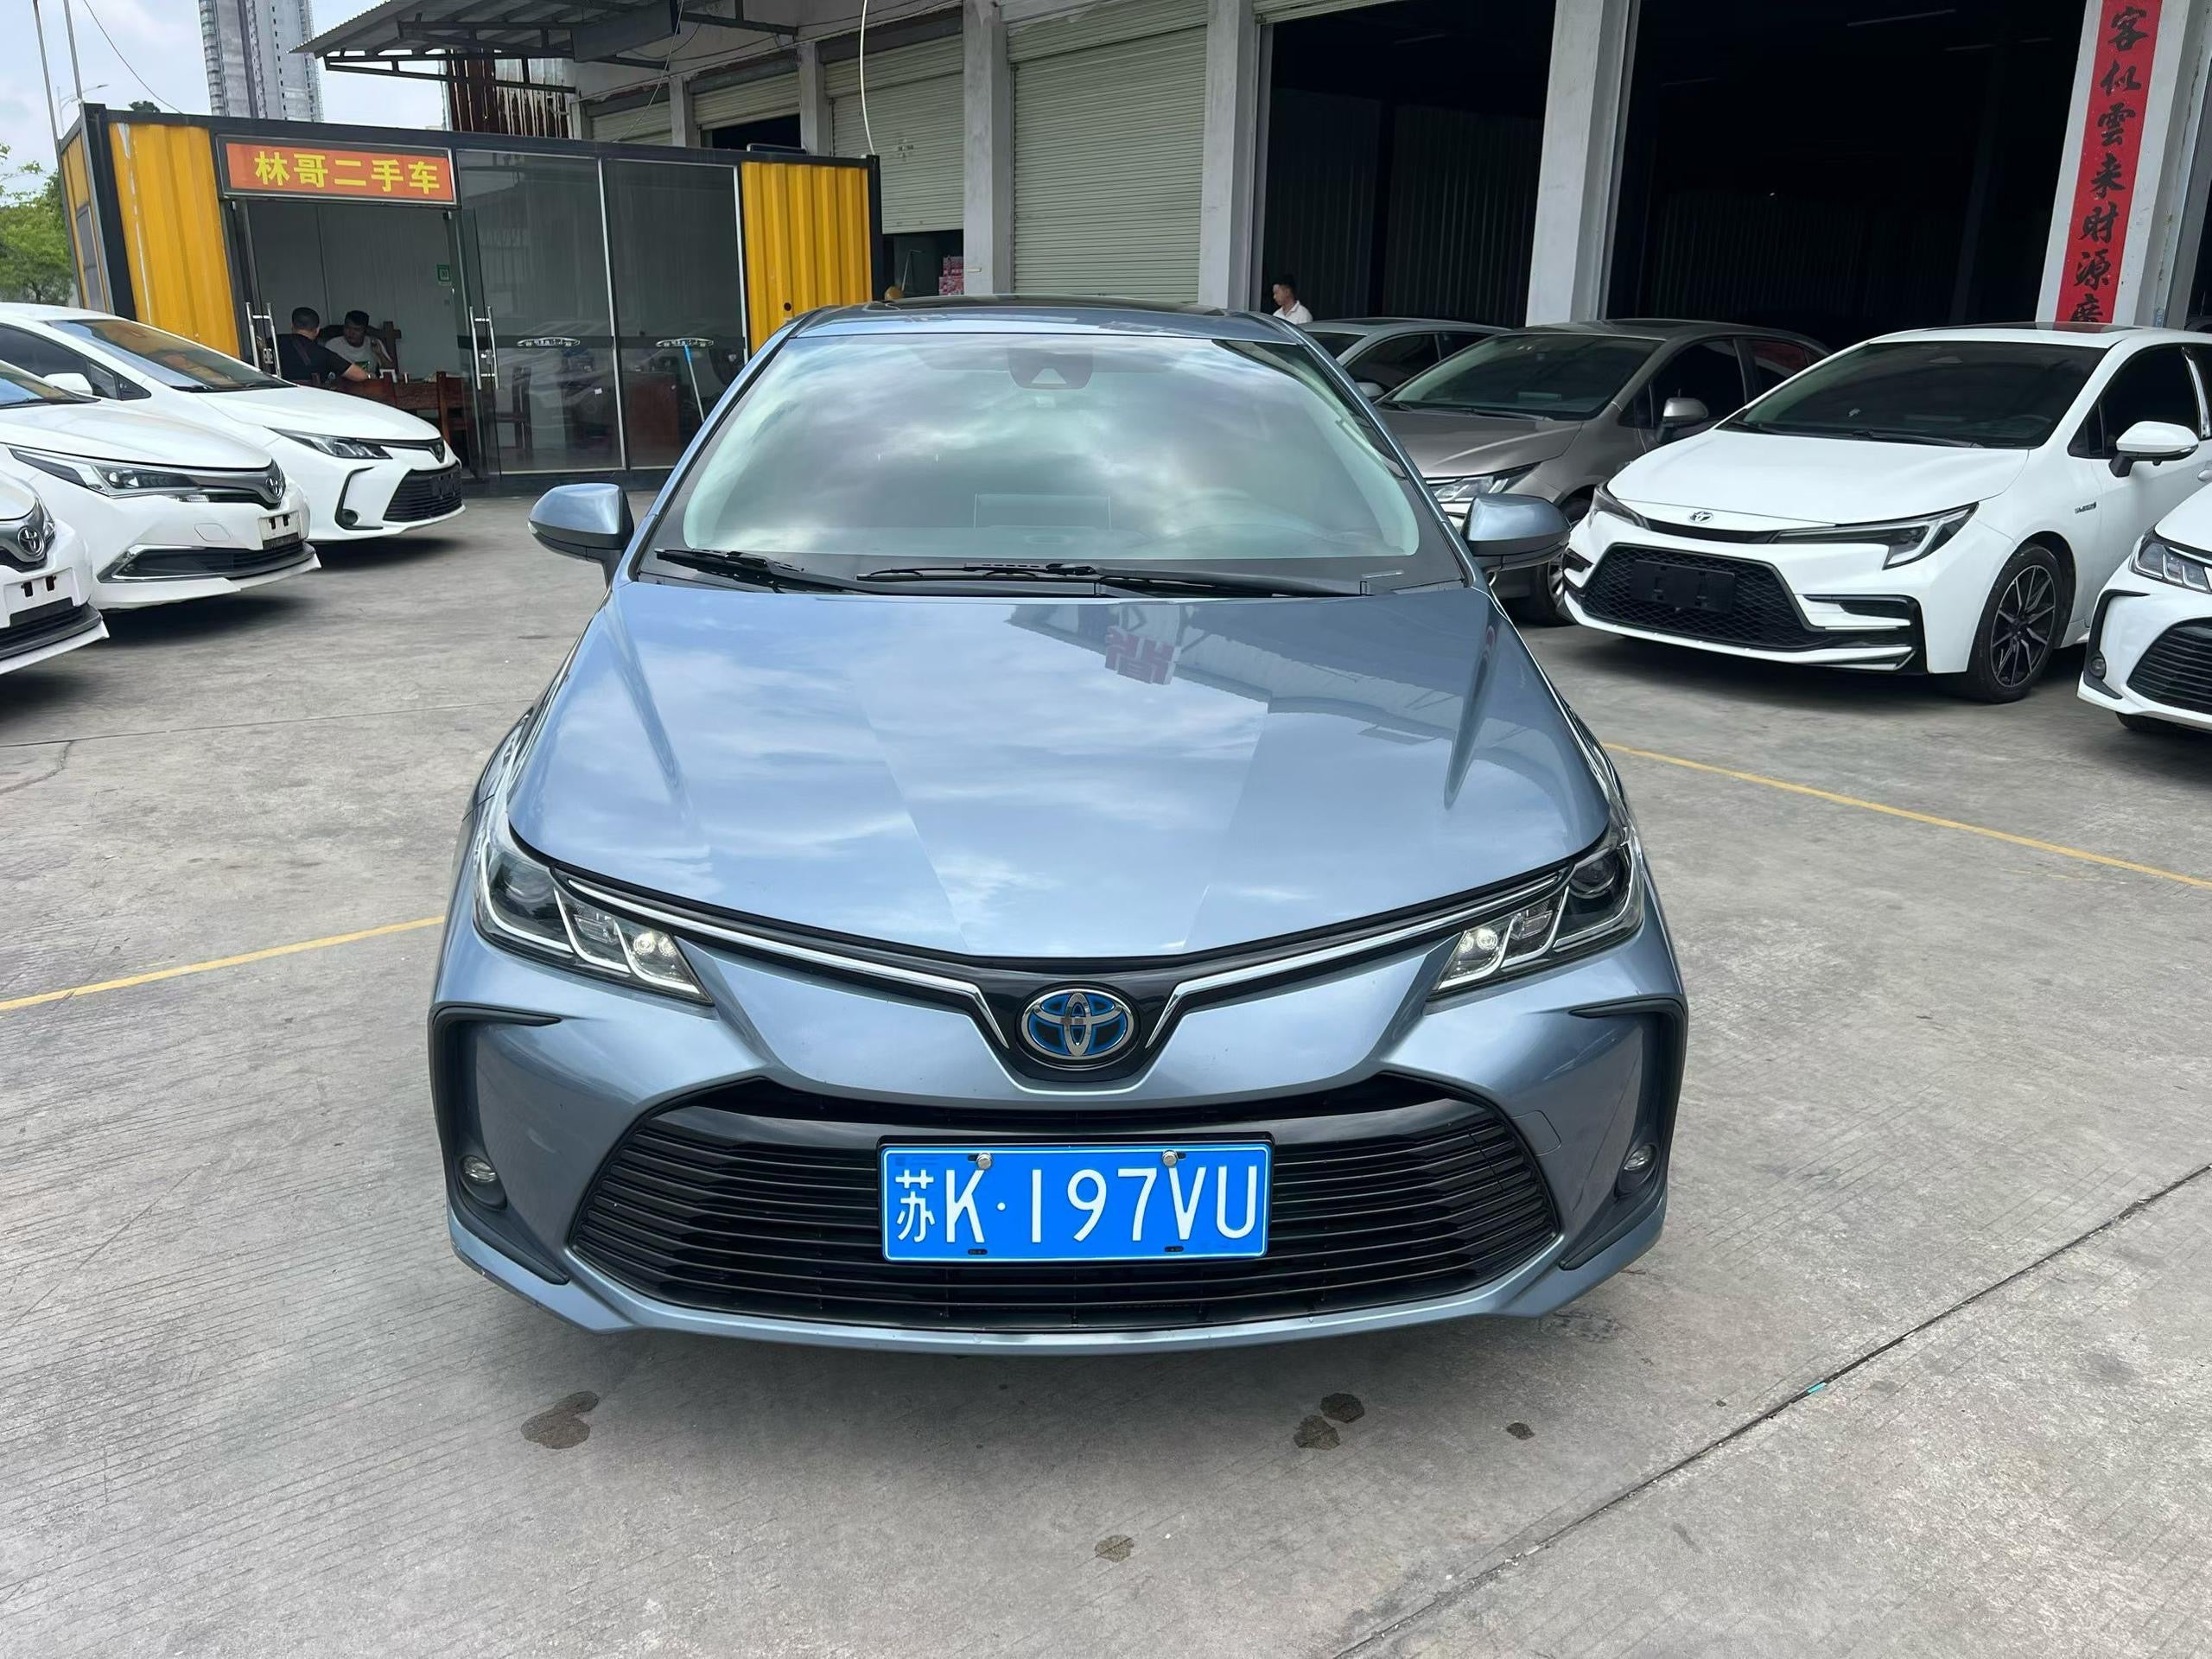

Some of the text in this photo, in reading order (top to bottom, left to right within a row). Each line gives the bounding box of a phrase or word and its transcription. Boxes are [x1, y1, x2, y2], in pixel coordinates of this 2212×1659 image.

[255, 151, 440, 194] 林哥二手车
